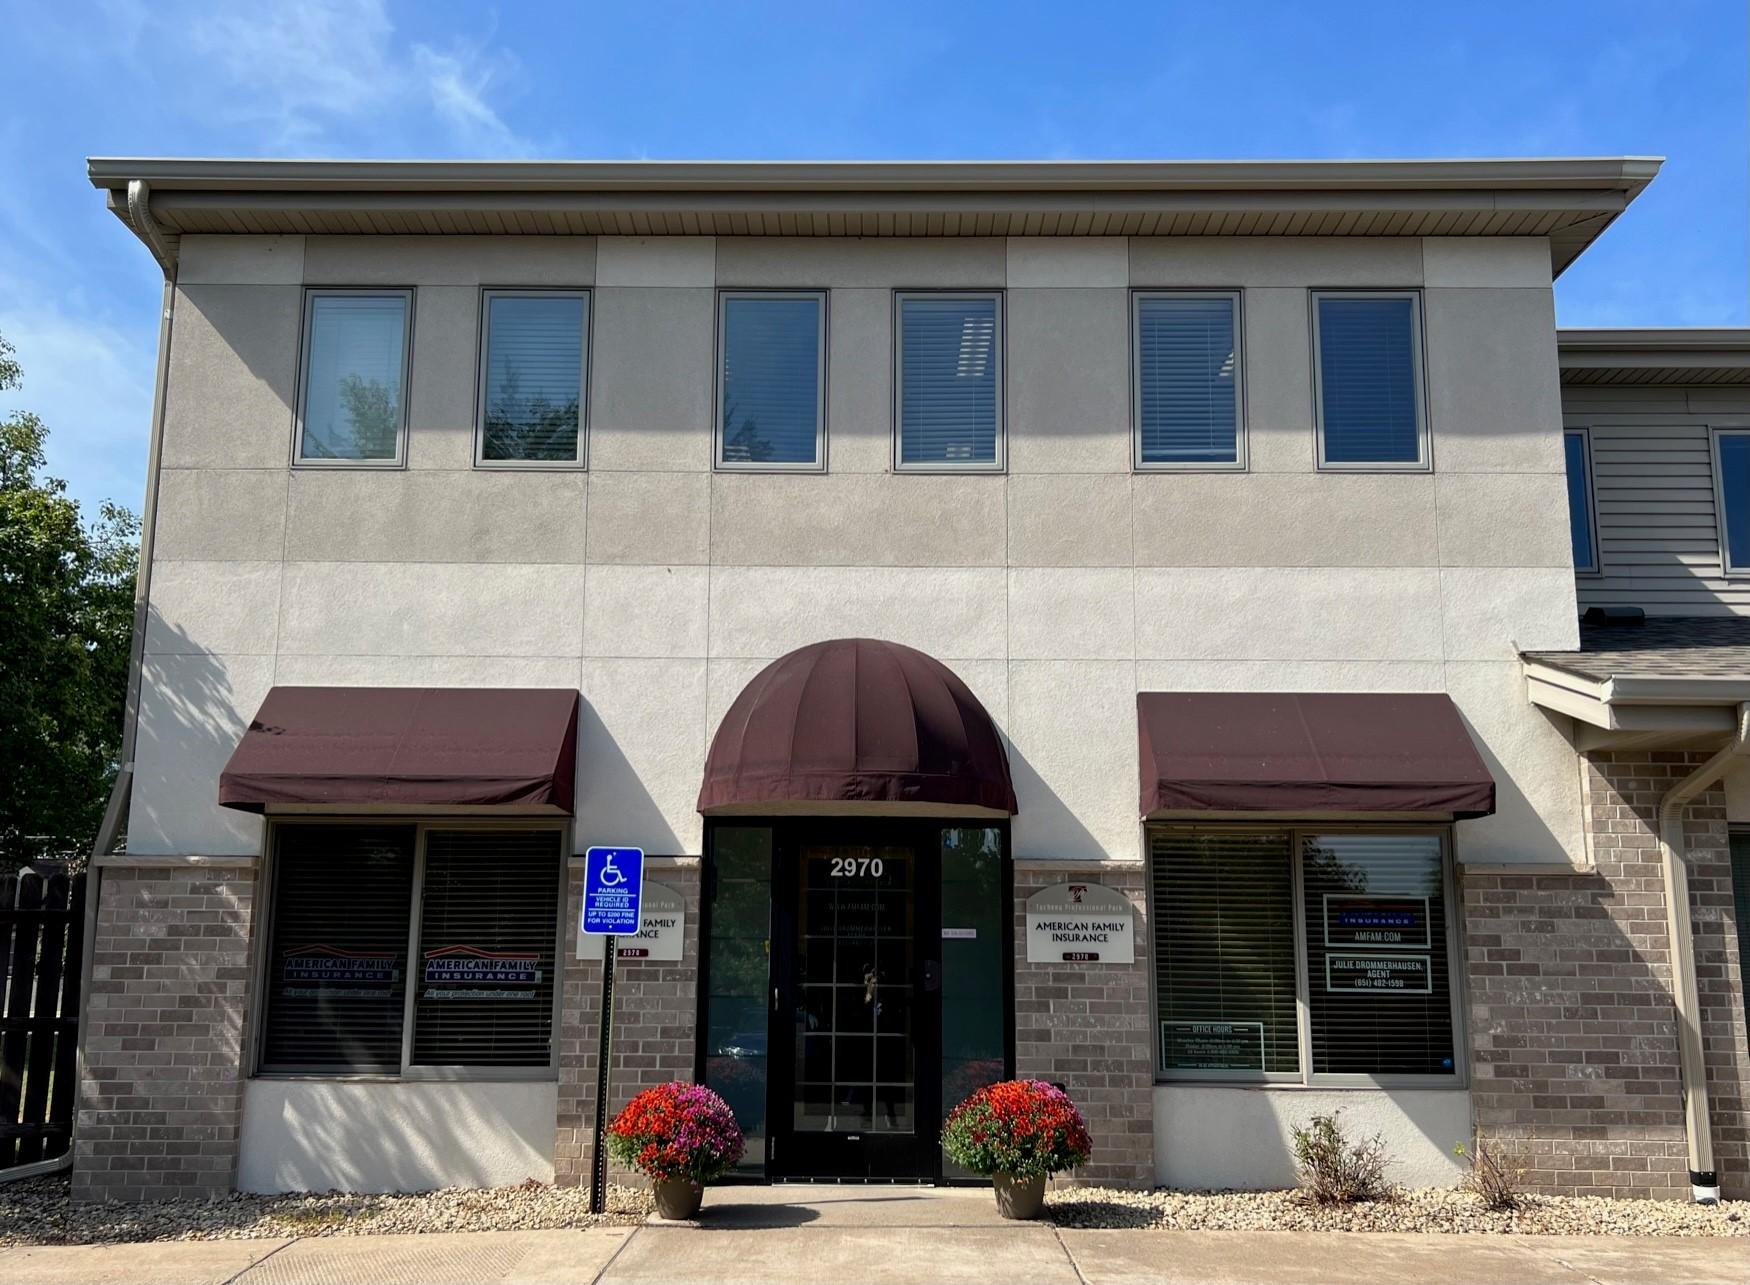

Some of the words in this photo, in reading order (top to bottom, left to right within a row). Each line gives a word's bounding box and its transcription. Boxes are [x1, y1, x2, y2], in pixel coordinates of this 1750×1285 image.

[830, 858, 884, 877] 2970
[643, 919, 676, 928] FAMILY
[1344, 917, 1409, 925] INSURANCE
[1035, 922, 1089, 931] AMERICAN
[1091, 922, 1125, 932] FAMILY
[1052, 933, 1109, 943] INSURANCE
[1354, 931, 1402, 942] AMFAM.COM
[286, 959, 349, 969] AMERICAN
[352, 960, 393, 969] FAMILY
[427, 960, 489, 970] AMERICAN
[493, 960, 537, 971] FAMILY
[1333, 960, 1355, 969] JULIE
[293, 971, 385, 979] INSURANCE
[434, 972, 527, 980] INSURANCE
[1367, 970, 1391, 978] AGENT
[1213, 1025, 1232, 1033] HOURS
